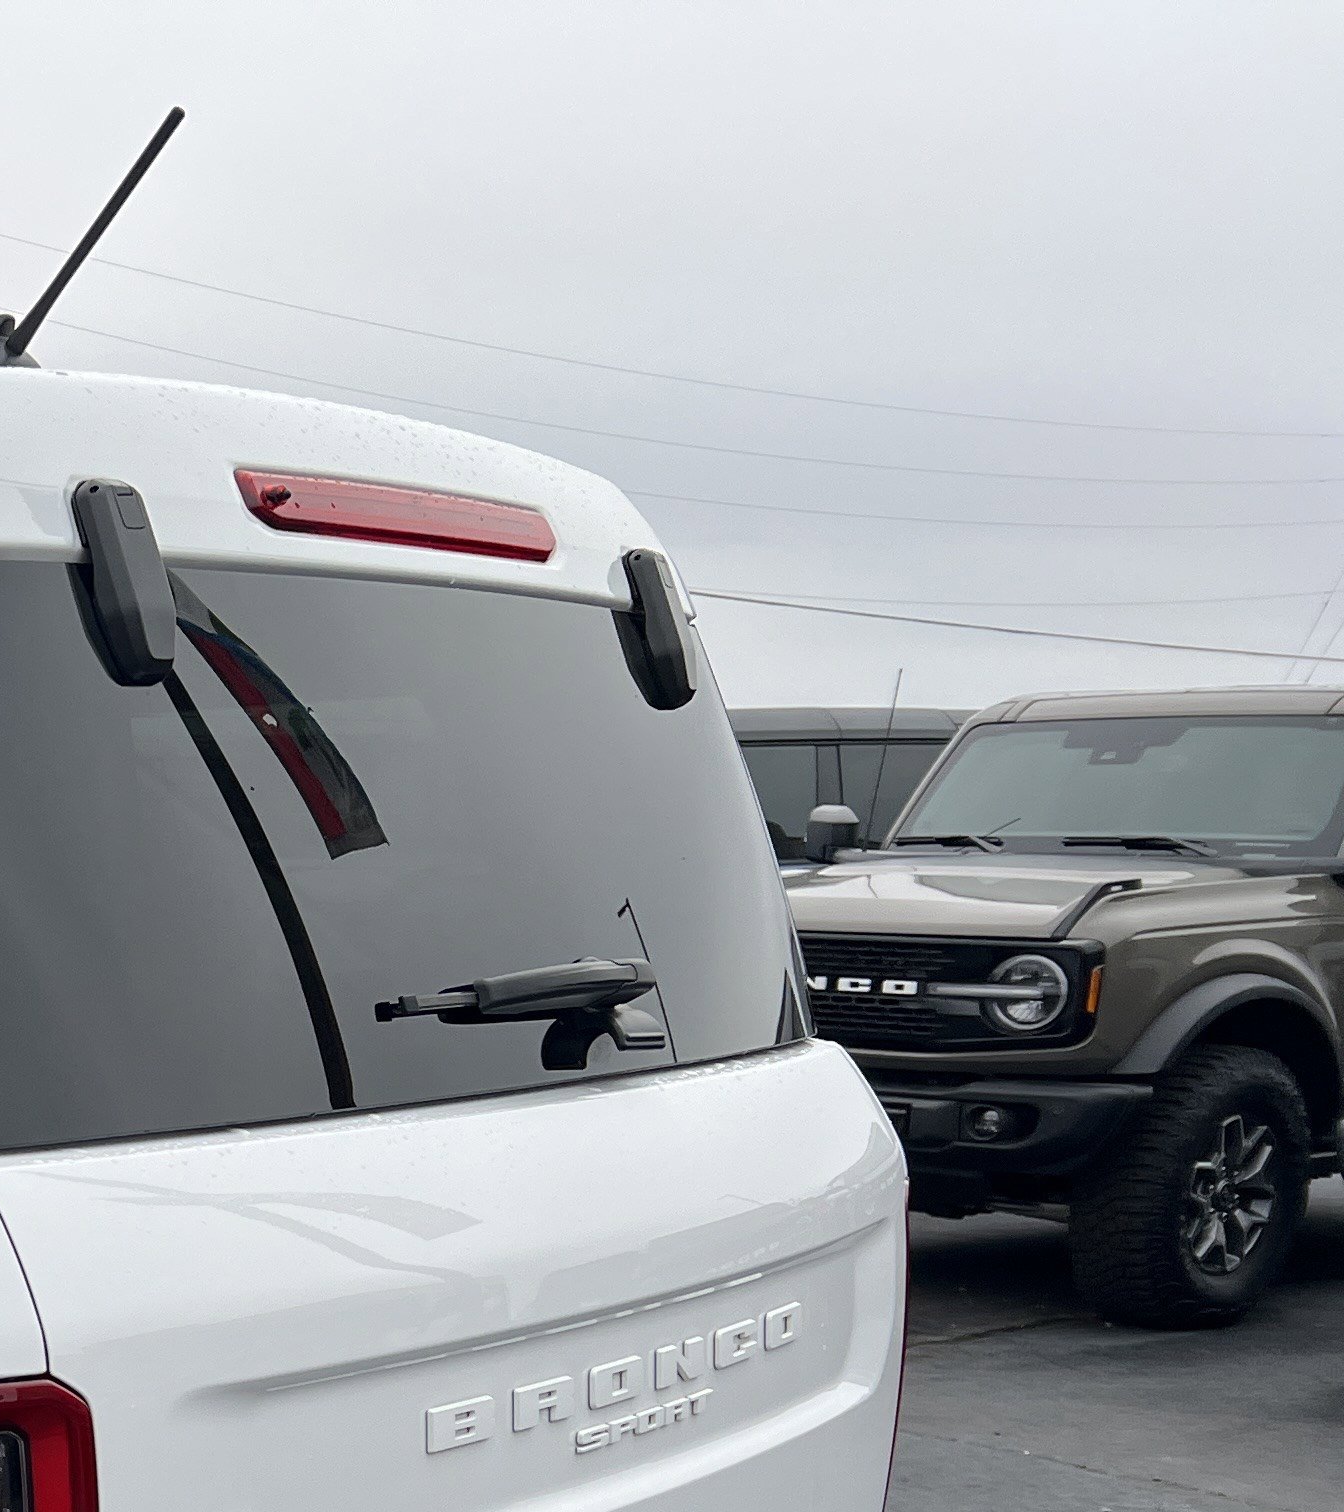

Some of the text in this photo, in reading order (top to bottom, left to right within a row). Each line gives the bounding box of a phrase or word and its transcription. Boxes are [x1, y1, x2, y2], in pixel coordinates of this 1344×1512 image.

[806, 974, 919, 996] NCO
[425, 1300, 803, 1454] BRONCO
[575, 1387, 715, 1454] SPORT
